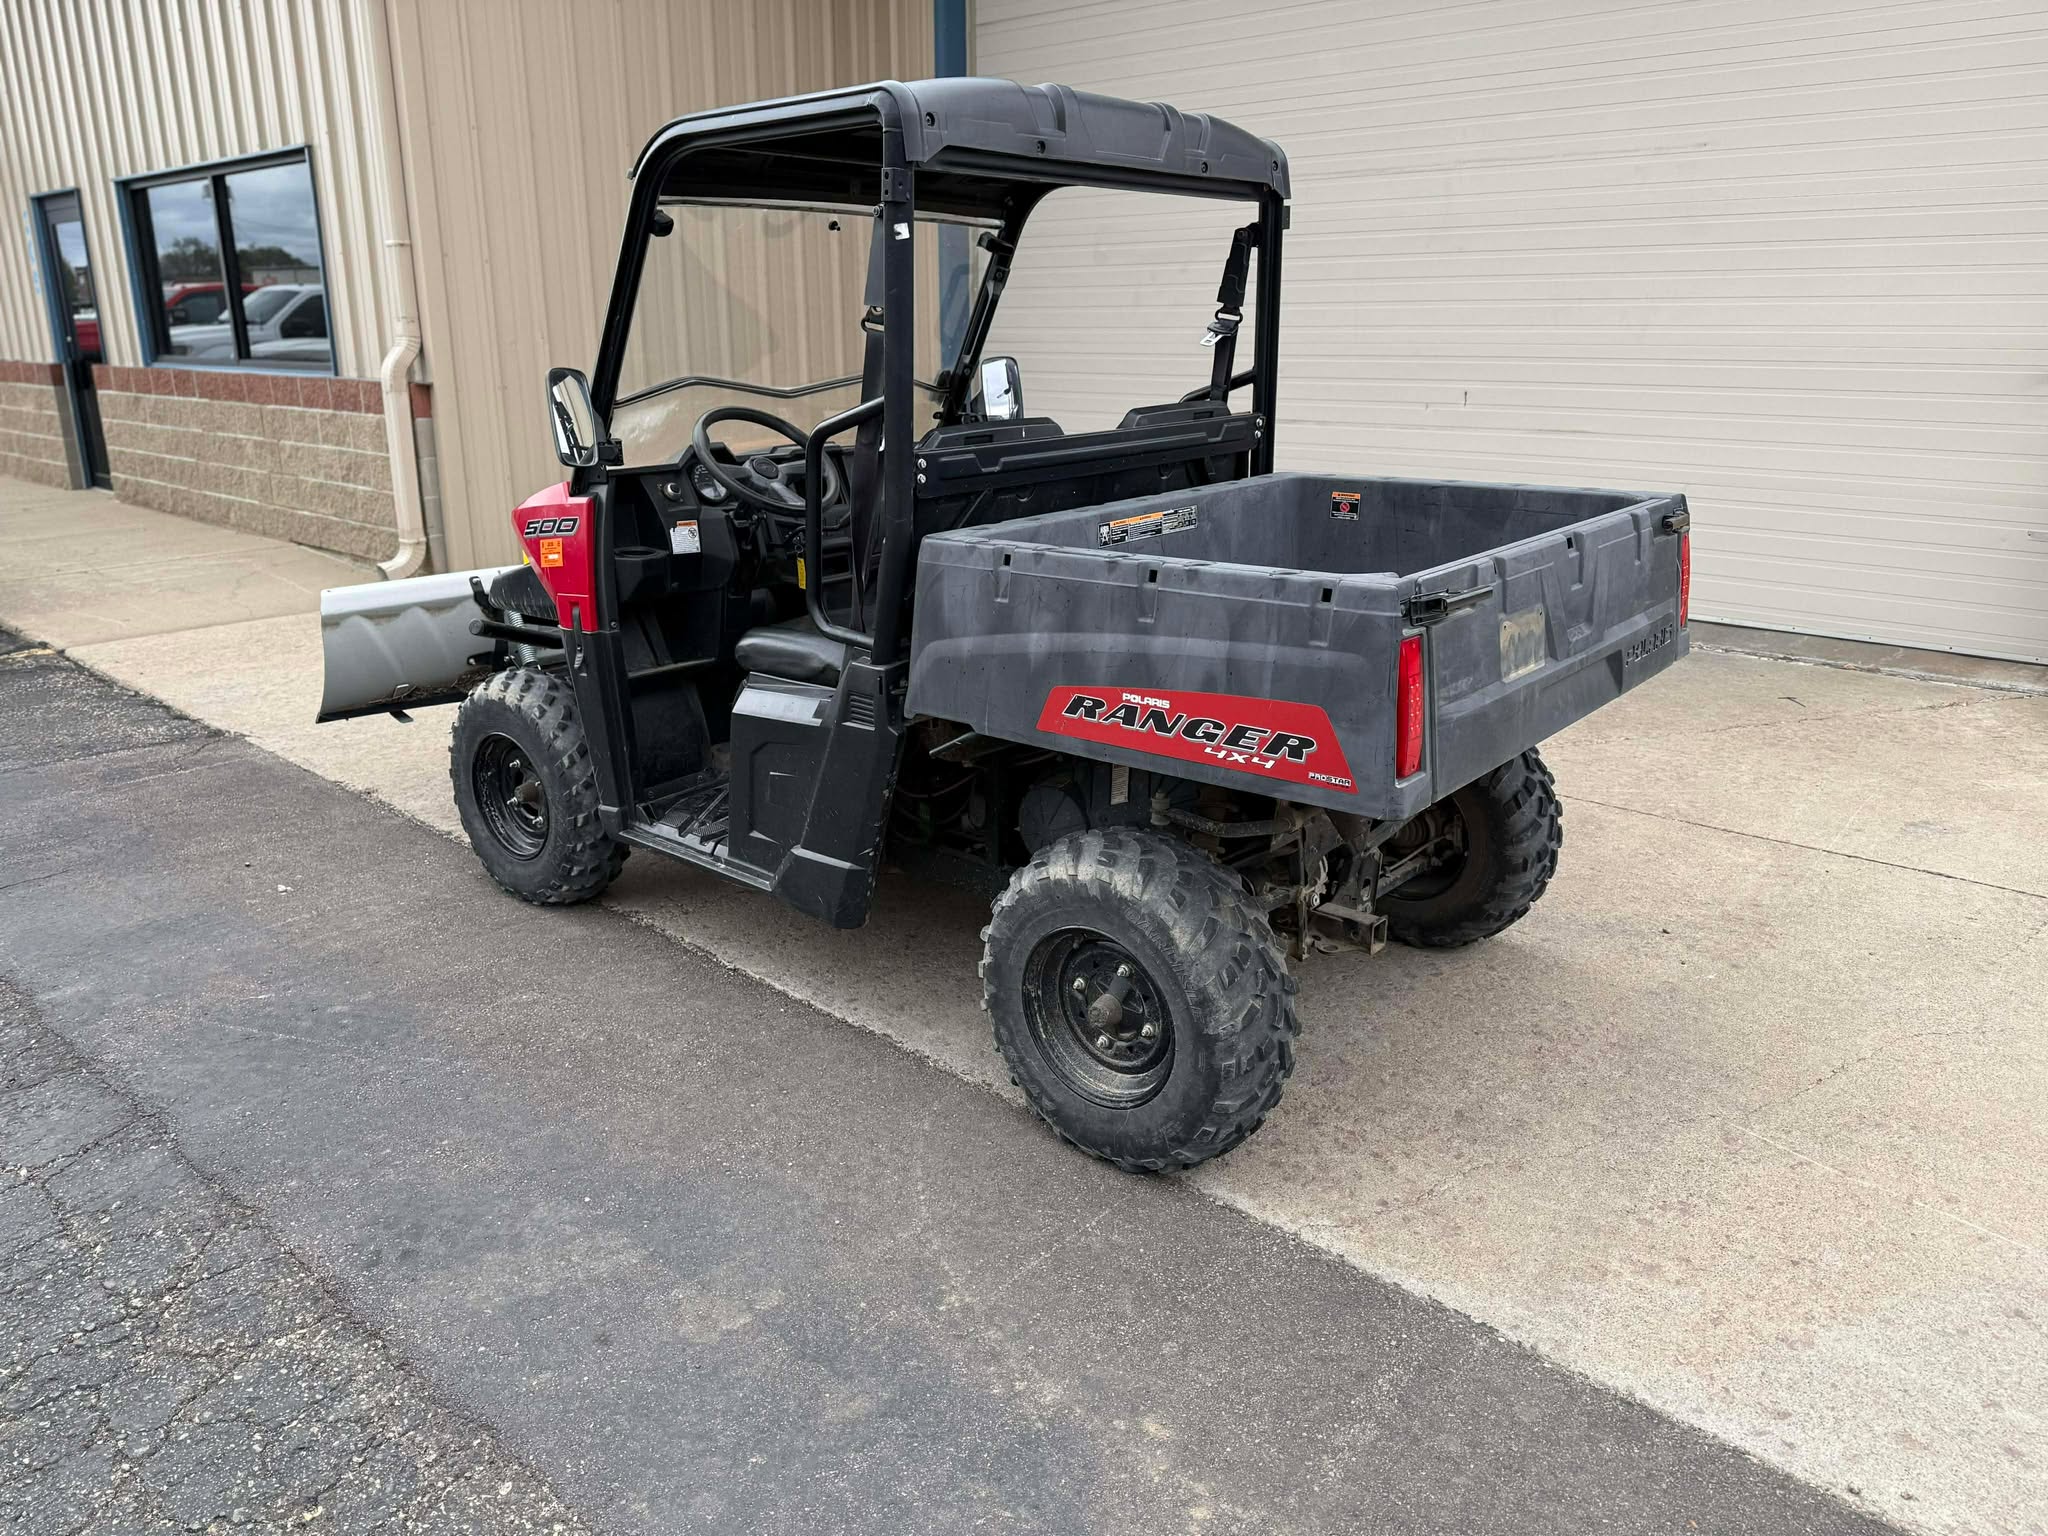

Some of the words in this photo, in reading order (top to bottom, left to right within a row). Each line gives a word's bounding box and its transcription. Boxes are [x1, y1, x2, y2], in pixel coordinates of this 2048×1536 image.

[523, 516, 580, 538] 500
[1122, 692, 1170, 709] POLARIS
[1062, 693, 1318, 763] RANGER
